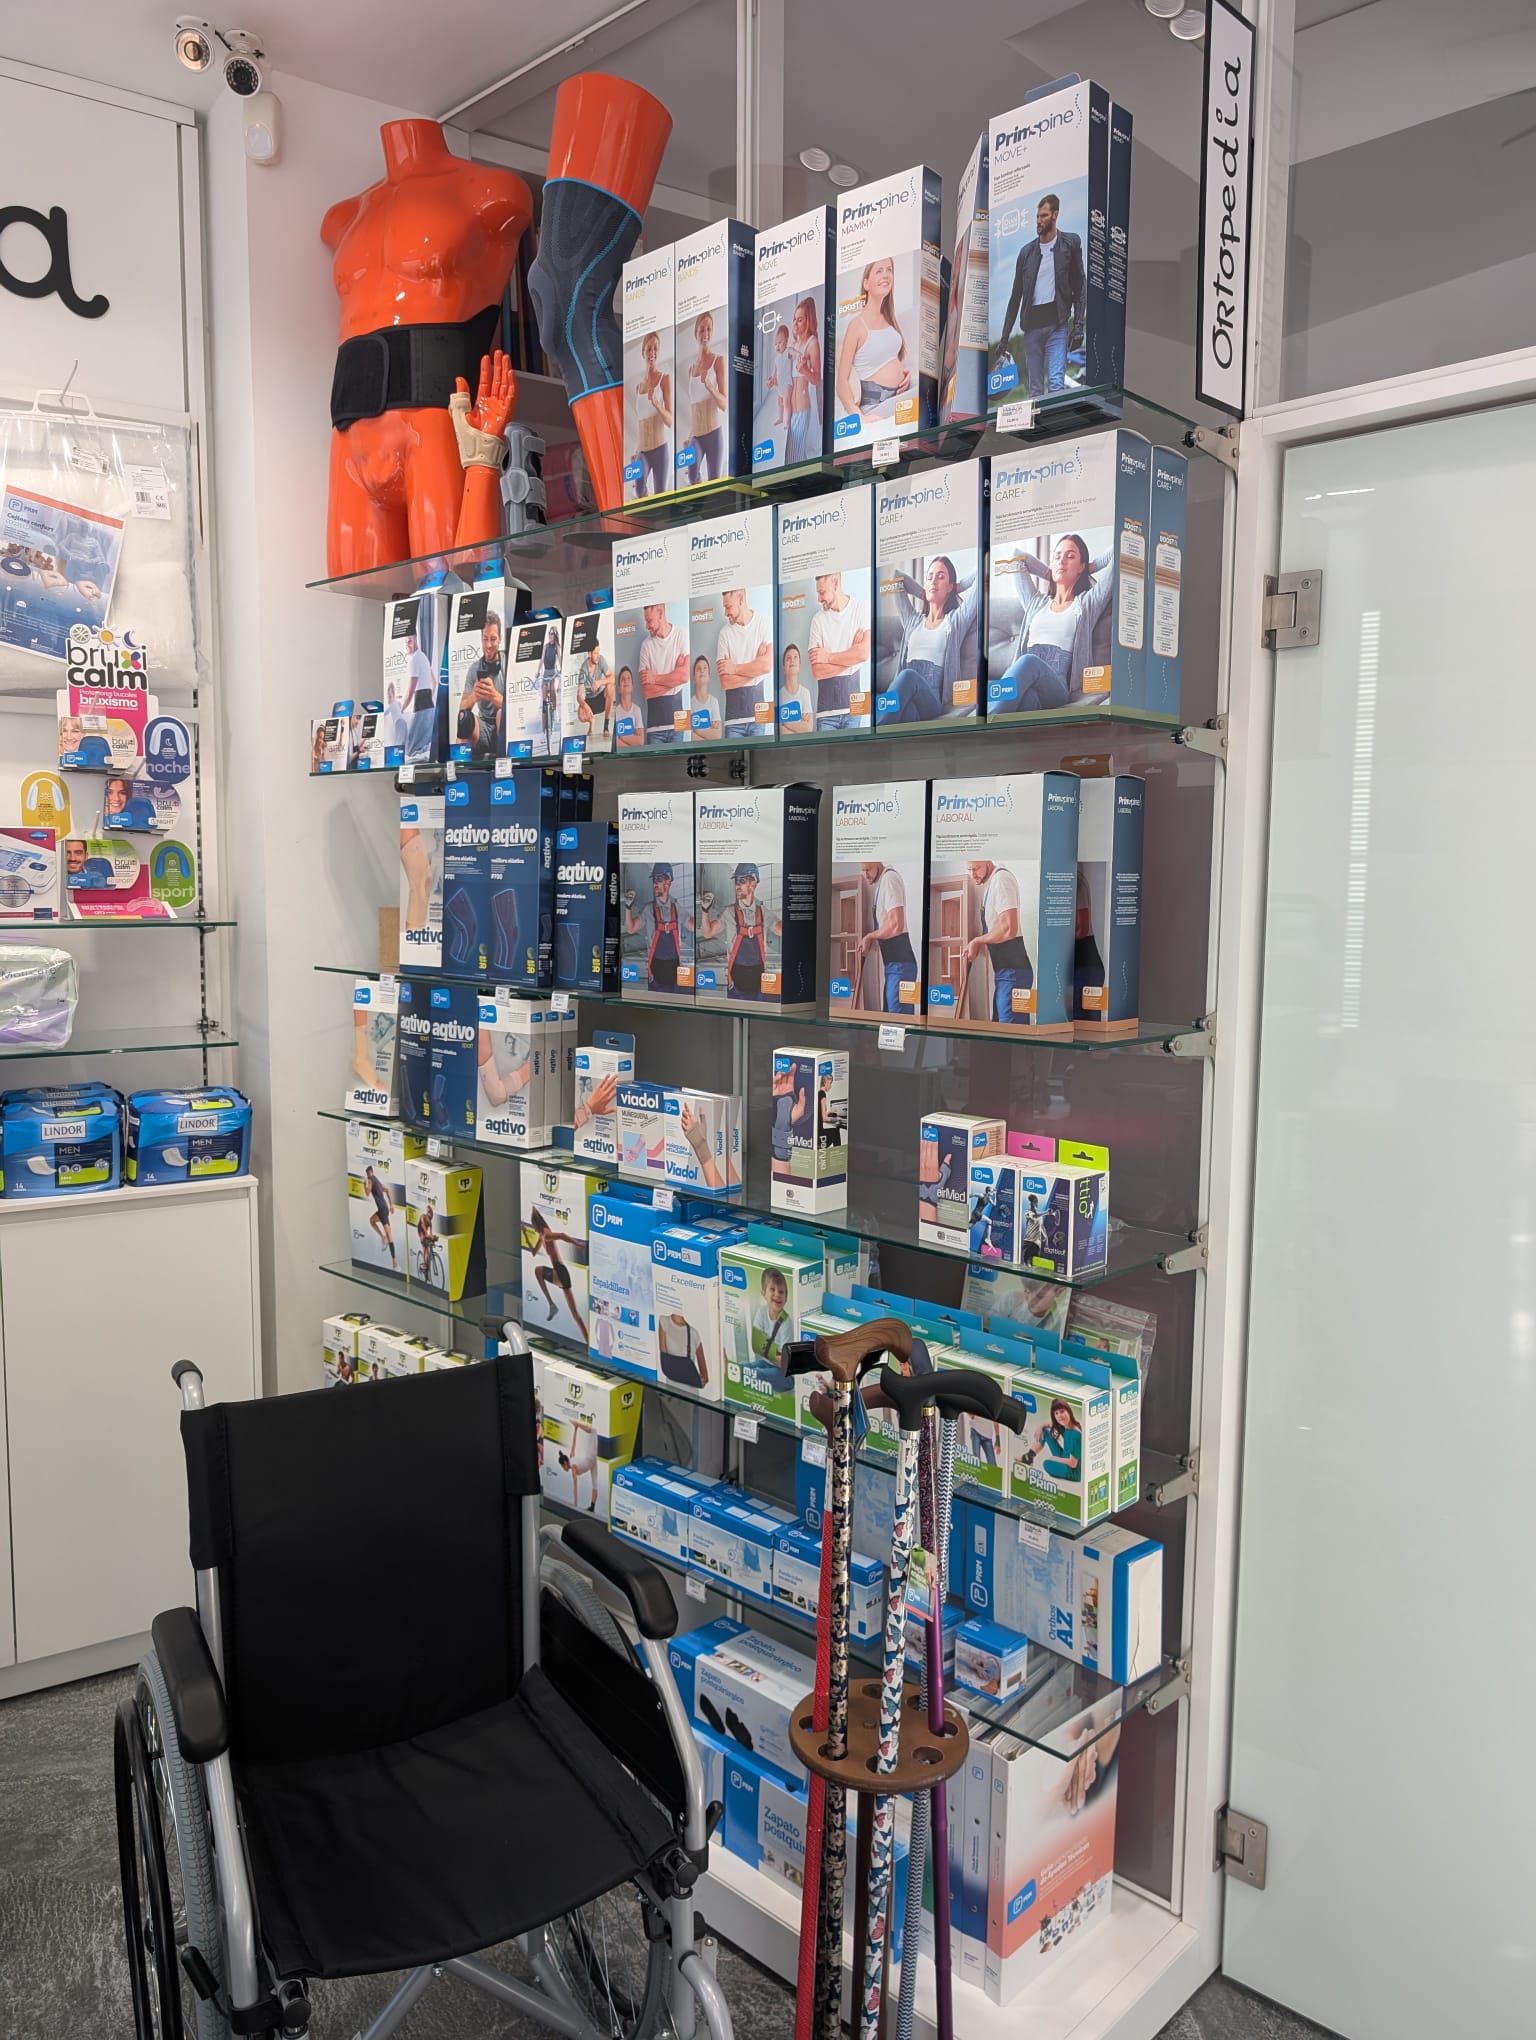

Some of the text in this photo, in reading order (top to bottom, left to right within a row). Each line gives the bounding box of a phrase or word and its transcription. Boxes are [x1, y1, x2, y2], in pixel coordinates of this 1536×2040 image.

[994, 146, 1028, 166] MOVE+
[841, 217, 875, 237] MAMMY
[758, 259, 779, 274] MOVE
[1002, 373, 1015, 384] PRIM
[995, 488, 1025, 502] CARE+
[879, 513, 904, 526] CARE+
[781, 534, 800, 546] CARE
[690, 551, 708, 562] CARE
[616, 567, 631, 578] CARE
[451, 644, 481, 662] airtex
[68, 664, 148, 690] calm
[508, 676, 539, 694] airtex
[80, 693, 138, 708] bruxismo
[113, 690, 138, 698] bucales
[146, 761, 190, 774] noche
[699, 822, 734, 830] LABORAL+
[835, 817, 868, 827] LABORAL
[936, 812, 974, 823] LABORAL
[445, 823, 490, 847] aqtivo
[491, 823, 538, 847] aqtivo
[621, 823, 650, 831] LABORAL+
[543, 836, 552, 869] aqtivo
[556, 860, 605, 885] aqtivo
[152, 885, 195, 900] sport
[609, 872, 618, 905] aqtivo
[400, 1013, 431, 1034] aqtivo
[432, 1019, 475, 1041] aqtivo
[353, 1088, 388, 1106] aqtivo
[621, 1091, 659, 1110] viadol
[44, 1125, 83, 1137] LINDOR
[179, 1118, 215, 1130] LINDOR
[485, 1117, 526, 1136] aqtivo
[58, 1145, 81, 1154] MEN
[192, 1138, 212, 1146] MEN
[583, 1137, 615, 1154] aqtivo
[787, 1134, 813, 1148] airMed
[666, 1160, 698, 1180] Viadol
[607, 1214, 623, 1226] PRIM
[592, 1275, 630, 1296] Espaldillera
[671, 1274, 705, 1291] Excellent
[743, 1366, 757, 1378] my
[743, 1375, 773, 1396] PRIM
[955, 1452, 980, 1467] PRIM
[1029, 1469, 1044, 1479] my
[1029, 1477, 1057, 1494] PRIM
[809, 1487, 817, 1508] PRIM
[975, 1560, 983, 1583] PRIM
[1048, 1604, 1057, 1641] Orthos
[1057, 1607, 1074, 1649] AZ
[680, 1661, 692, 1672] PRIM
[700, 1668, 722, 1685] Zapato
[740, 1779, 754, 1792] PRIM
[763, 1806, 800, 1838] Zapato
[763, 1819, 806, 1853] postquir
